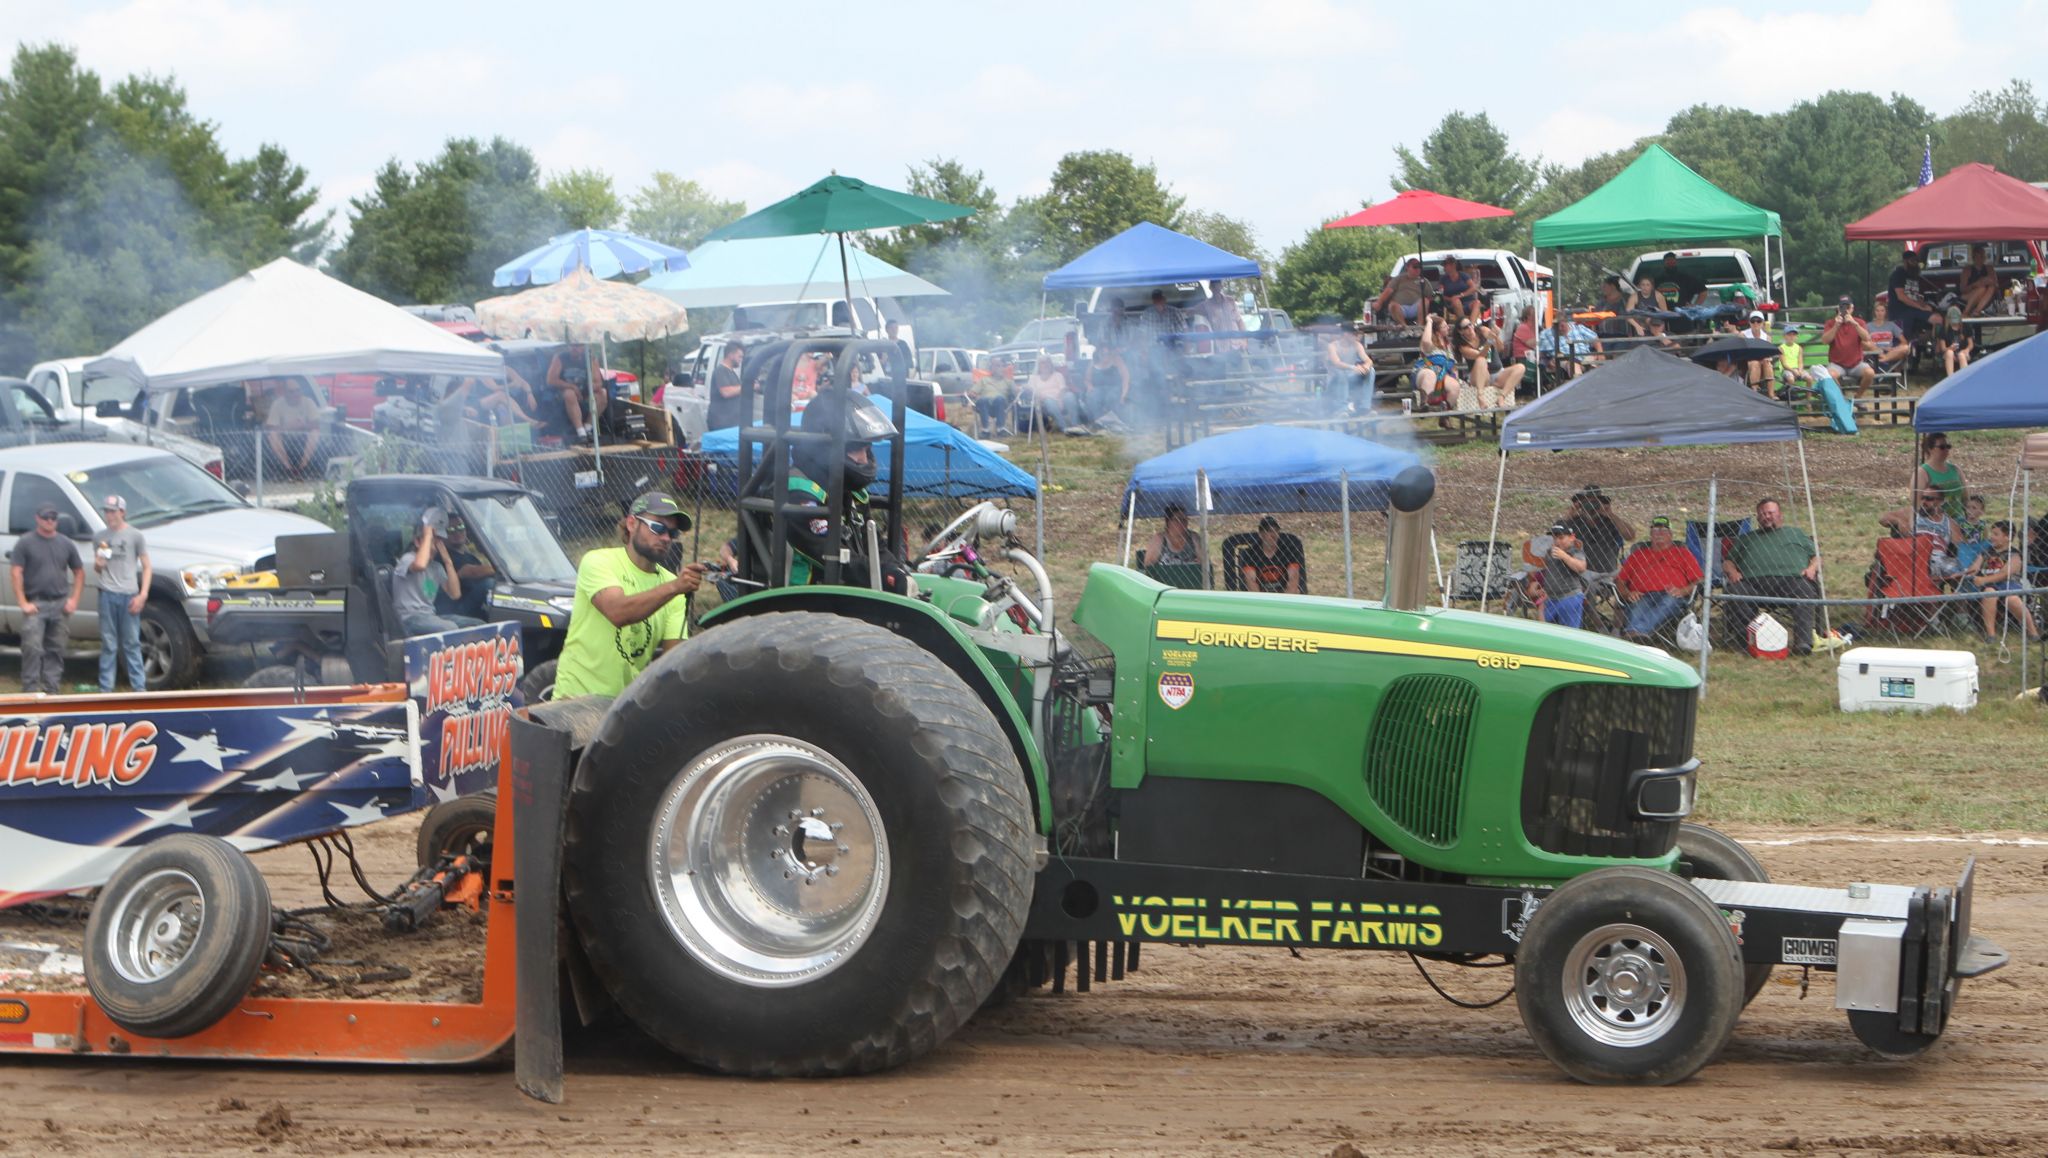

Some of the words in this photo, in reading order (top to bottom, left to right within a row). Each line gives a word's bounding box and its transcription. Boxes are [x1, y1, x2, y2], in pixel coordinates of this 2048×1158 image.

[426, 635, 518, 717] NEARPASS
[1477, 654, 1521, 670] 6615
[1113, 895, 1302, 941] VOELKER
[1311, 902, 1443, 946] FARMS
[1784, 939, 1836, 956] CROWER
